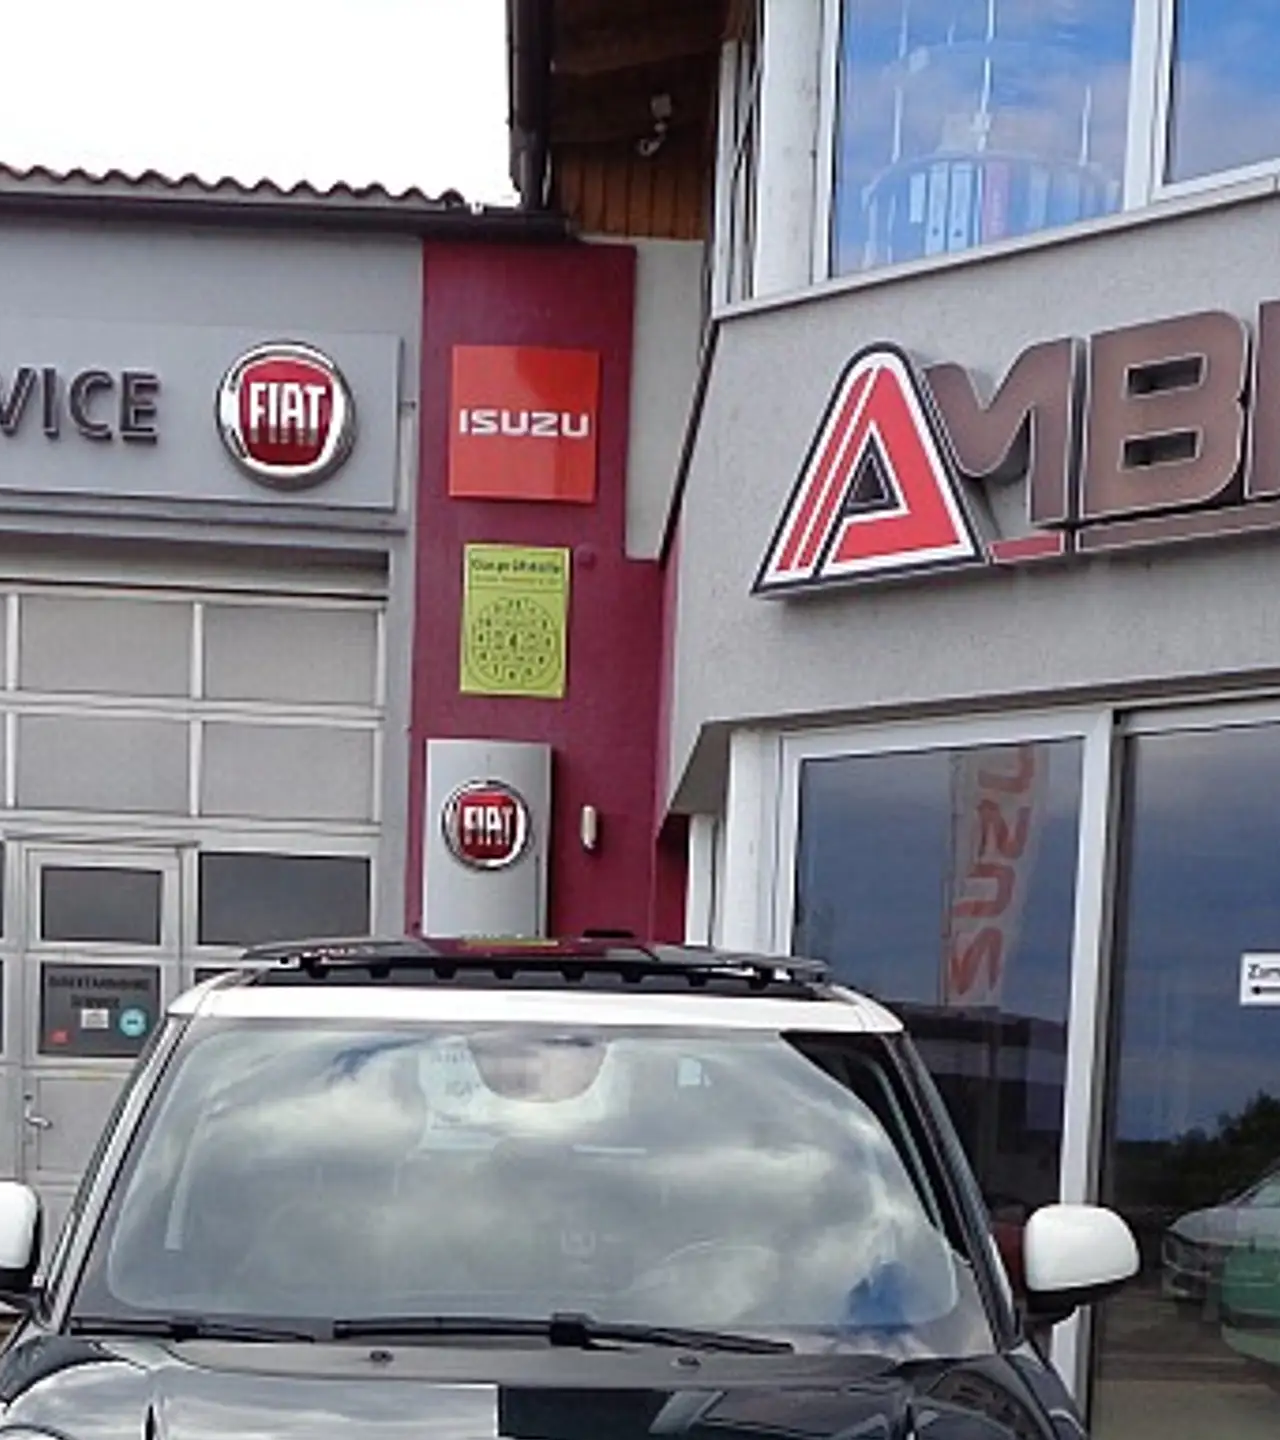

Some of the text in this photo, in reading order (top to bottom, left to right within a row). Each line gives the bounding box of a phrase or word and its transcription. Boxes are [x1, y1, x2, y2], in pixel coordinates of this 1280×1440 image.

[248, 380, 326, 444] FIAT
[459, 408, 589, 437] ISUZU
[464, 805, 514, 845] FIAT
[1248, 963, 1280, 979] Zum
